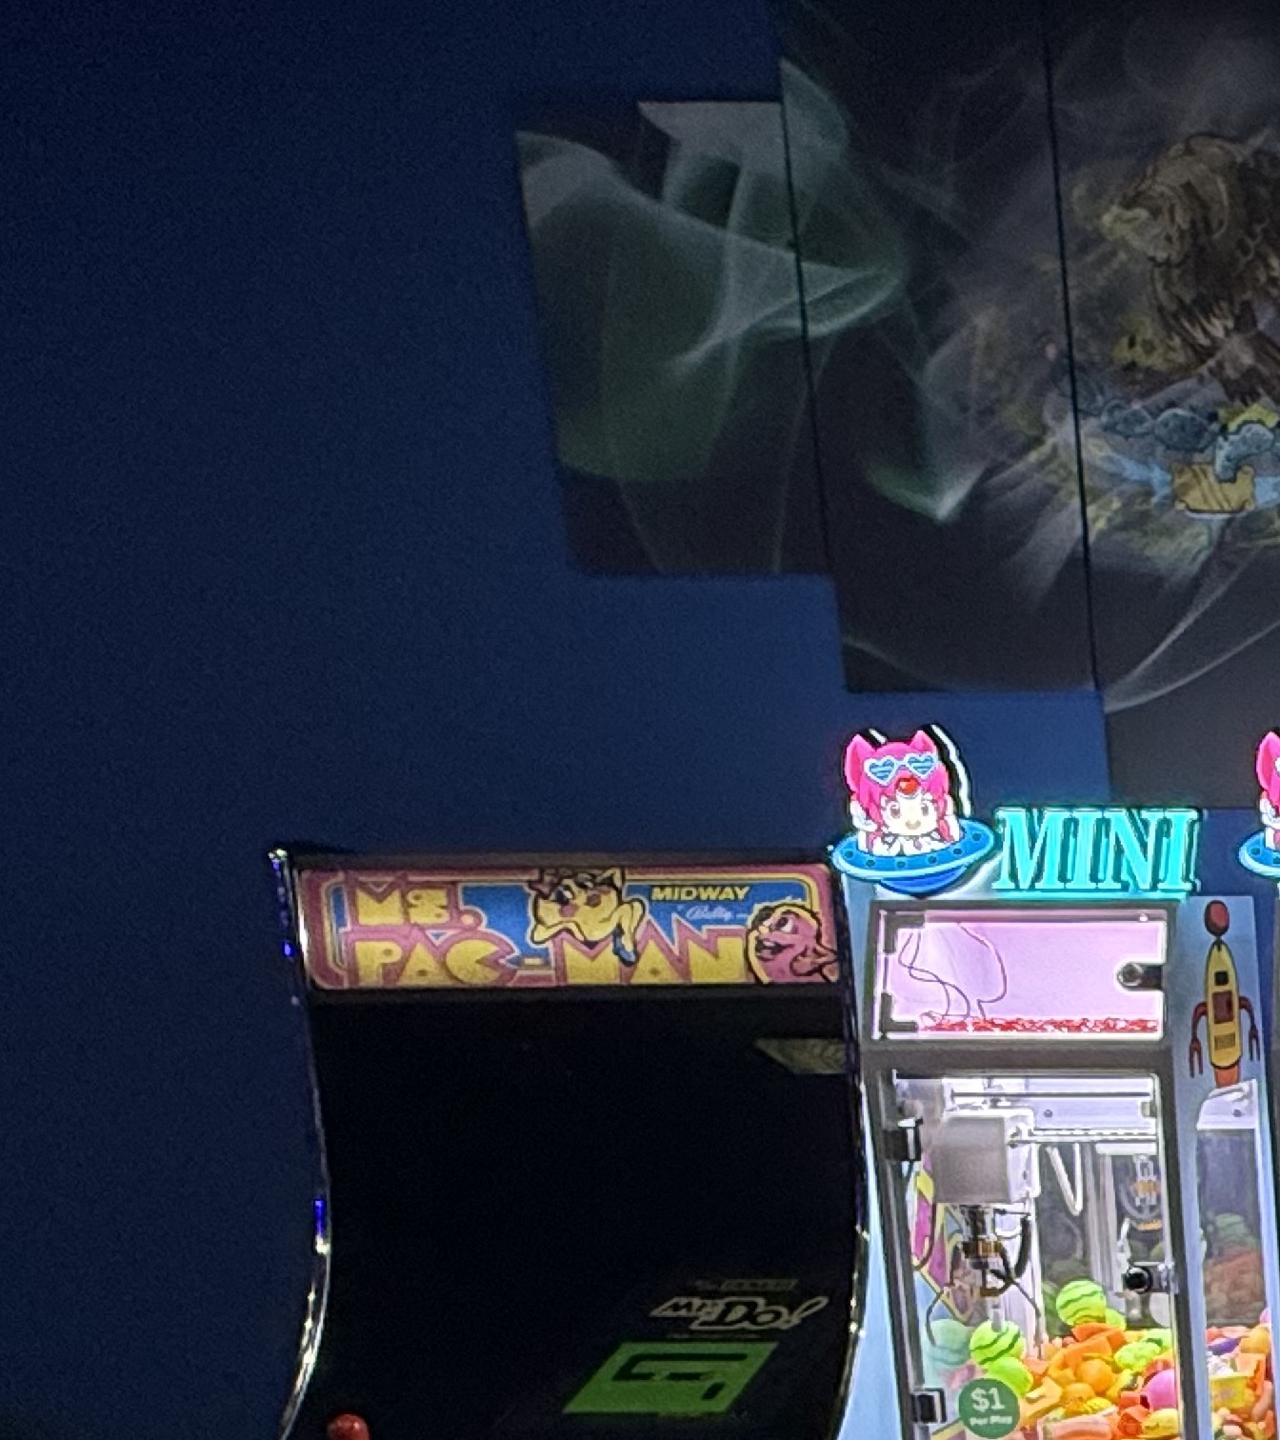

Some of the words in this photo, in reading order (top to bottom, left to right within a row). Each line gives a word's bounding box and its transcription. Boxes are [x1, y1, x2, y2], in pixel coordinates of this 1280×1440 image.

[993, 806, 1200, 892] MINI
[352, 884, 483, 928] MS.
[651, 885, 751, 901] MIDWAY
[353, 935, 747, 986] PAC-MAN
[970, 1387, 1005, 1413] $1
